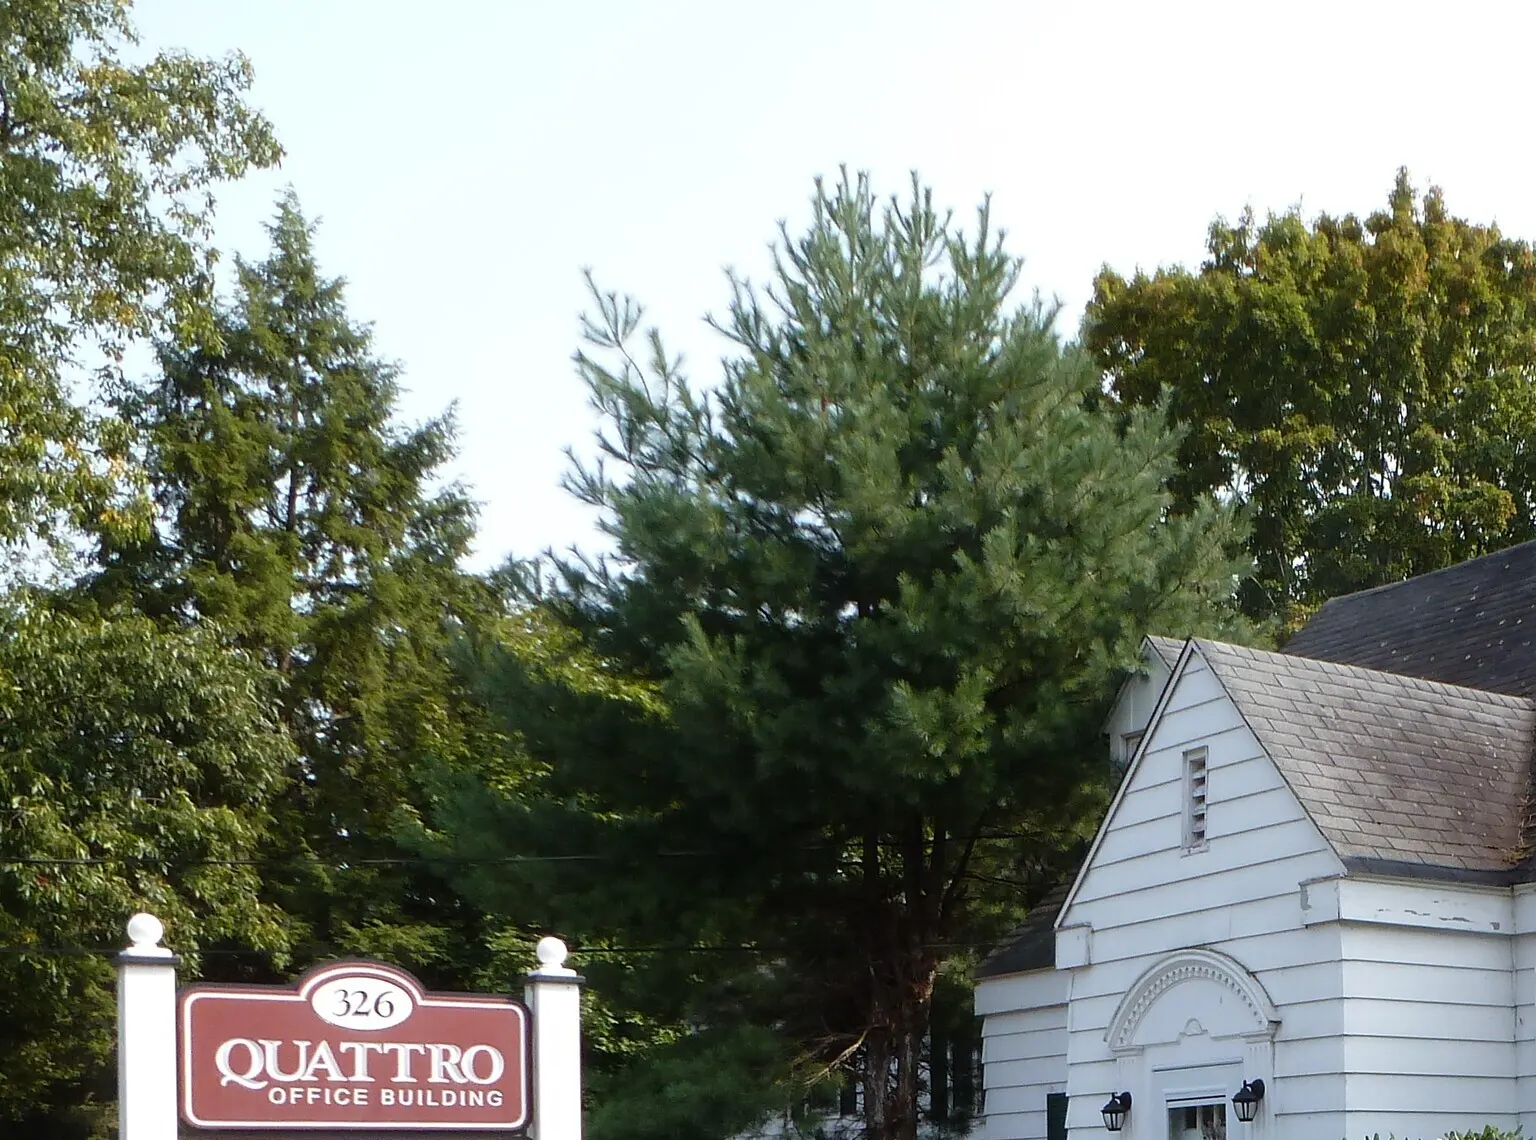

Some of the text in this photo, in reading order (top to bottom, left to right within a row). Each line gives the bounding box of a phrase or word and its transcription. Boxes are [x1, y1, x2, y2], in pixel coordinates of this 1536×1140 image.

[331, 988, 395, 1019] 326
[215, 1037, 505, 1090] QUATTRO
[268, 1087, 503, 1107] OFFICE BUILDING
